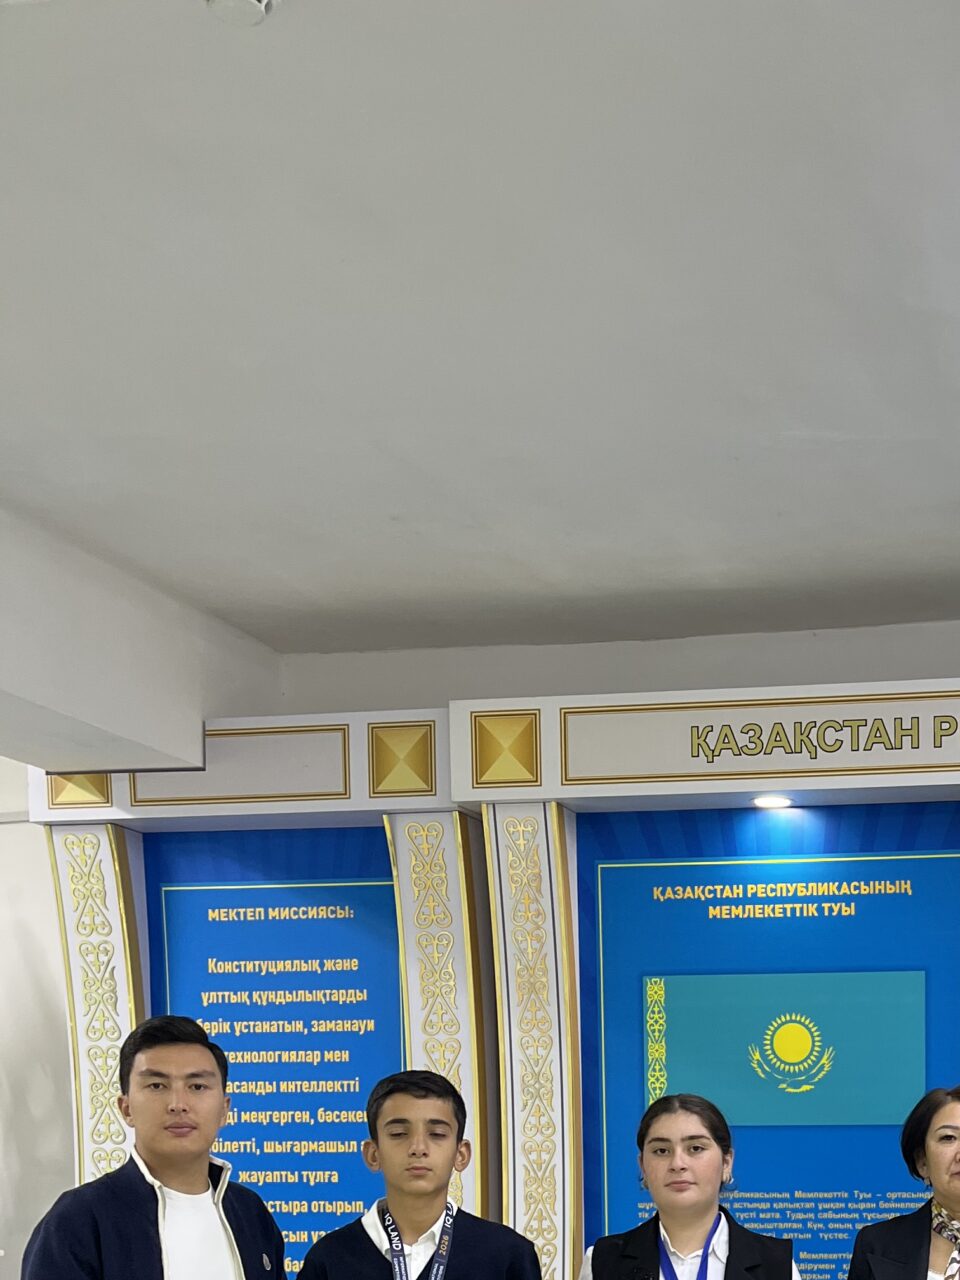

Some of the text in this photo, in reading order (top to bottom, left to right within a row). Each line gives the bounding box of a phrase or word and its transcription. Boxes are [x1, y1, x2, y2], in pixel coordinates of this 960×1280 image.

[691, 717, 919, 763] ҚАЗАҚСТАН
[653, 880, 912, 901] ҚАЗАҚСТАН РЕСПУБЛИКАСЫНЫҢ
[208, 906, 354, 921] МЕКТЕП МИССИЯСЫ:
[708, 903, 855, 919] МЕМЛЕКЕТТІК ТУЫ
[208, 958, 358, 975] Конституциялық және
[201, 989, 367, 1006] ұлттық құндылықтарды
[234, 1019, 308, 1036] ұстанатын,
[311, 1019, 375, 1034] заманауи
[324, 1051, 349, 1062] мен
[226, 1078, 359, 1095] асанды интеллектті
[241, 1111, 314, 1125] меңгерген,
[210, 1138, 357, 1155] білетті, шығармашыл
[239, 1171, 338, 1186] жауапты тұлға
[854, 1191, 871, 1199] Туы
[267, 1200, 368, 1216] стыра отырып,
[444, 1217, 453, 1227] IQ
[384, 1213, 401, 1250] IQ LAND
[439, 1235, 449, 1255] 2026
